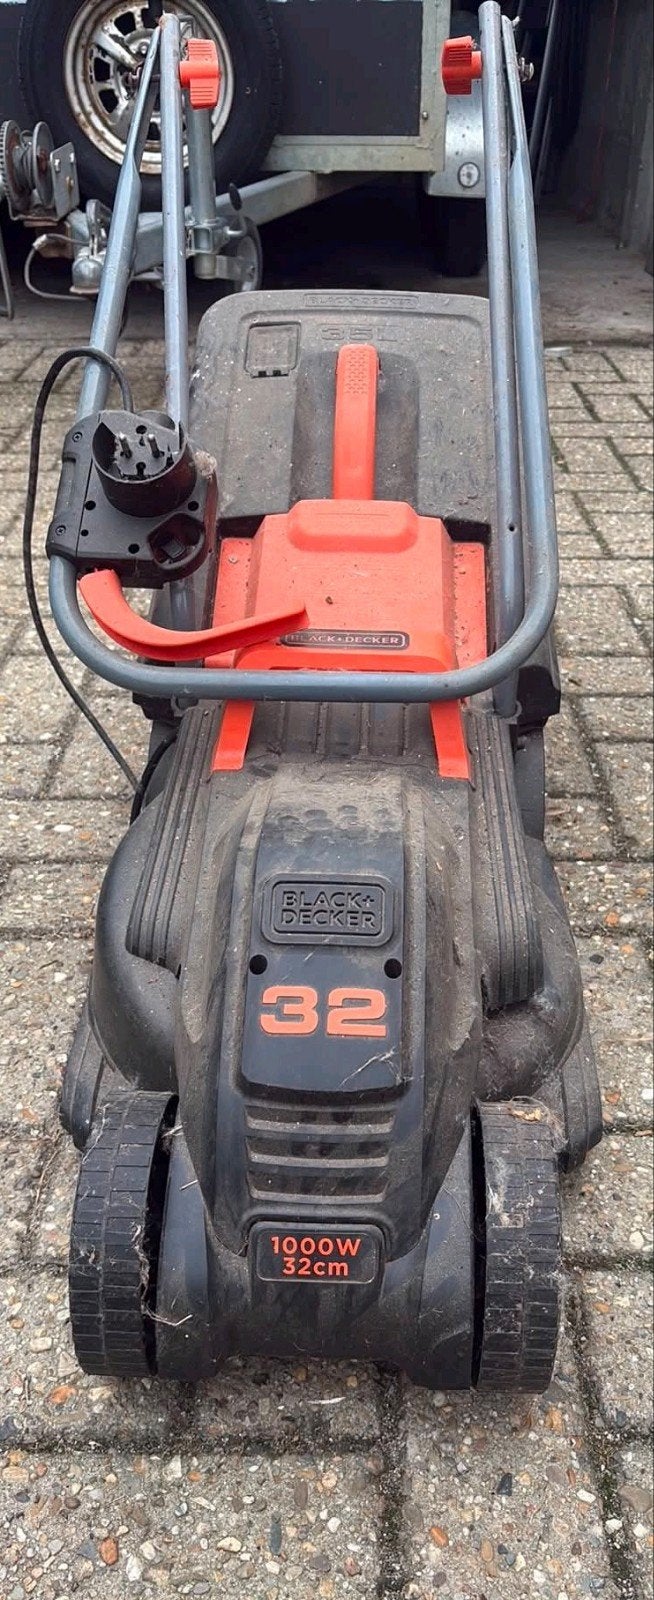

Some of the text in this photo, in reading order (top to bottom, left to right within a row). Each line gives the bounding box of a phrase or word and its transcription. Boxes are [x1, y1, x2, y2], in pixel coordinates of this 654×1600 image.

[319, 324, 399, 341] 35L
[282, 890, 375, 908] BLACK+
[281, 908, 376, 927] DECKER
[260, 985, 387, 1037] 32
[271, 1236, 361, 1256] 1000W
[282, 1257, 349, 1276] 32cm
